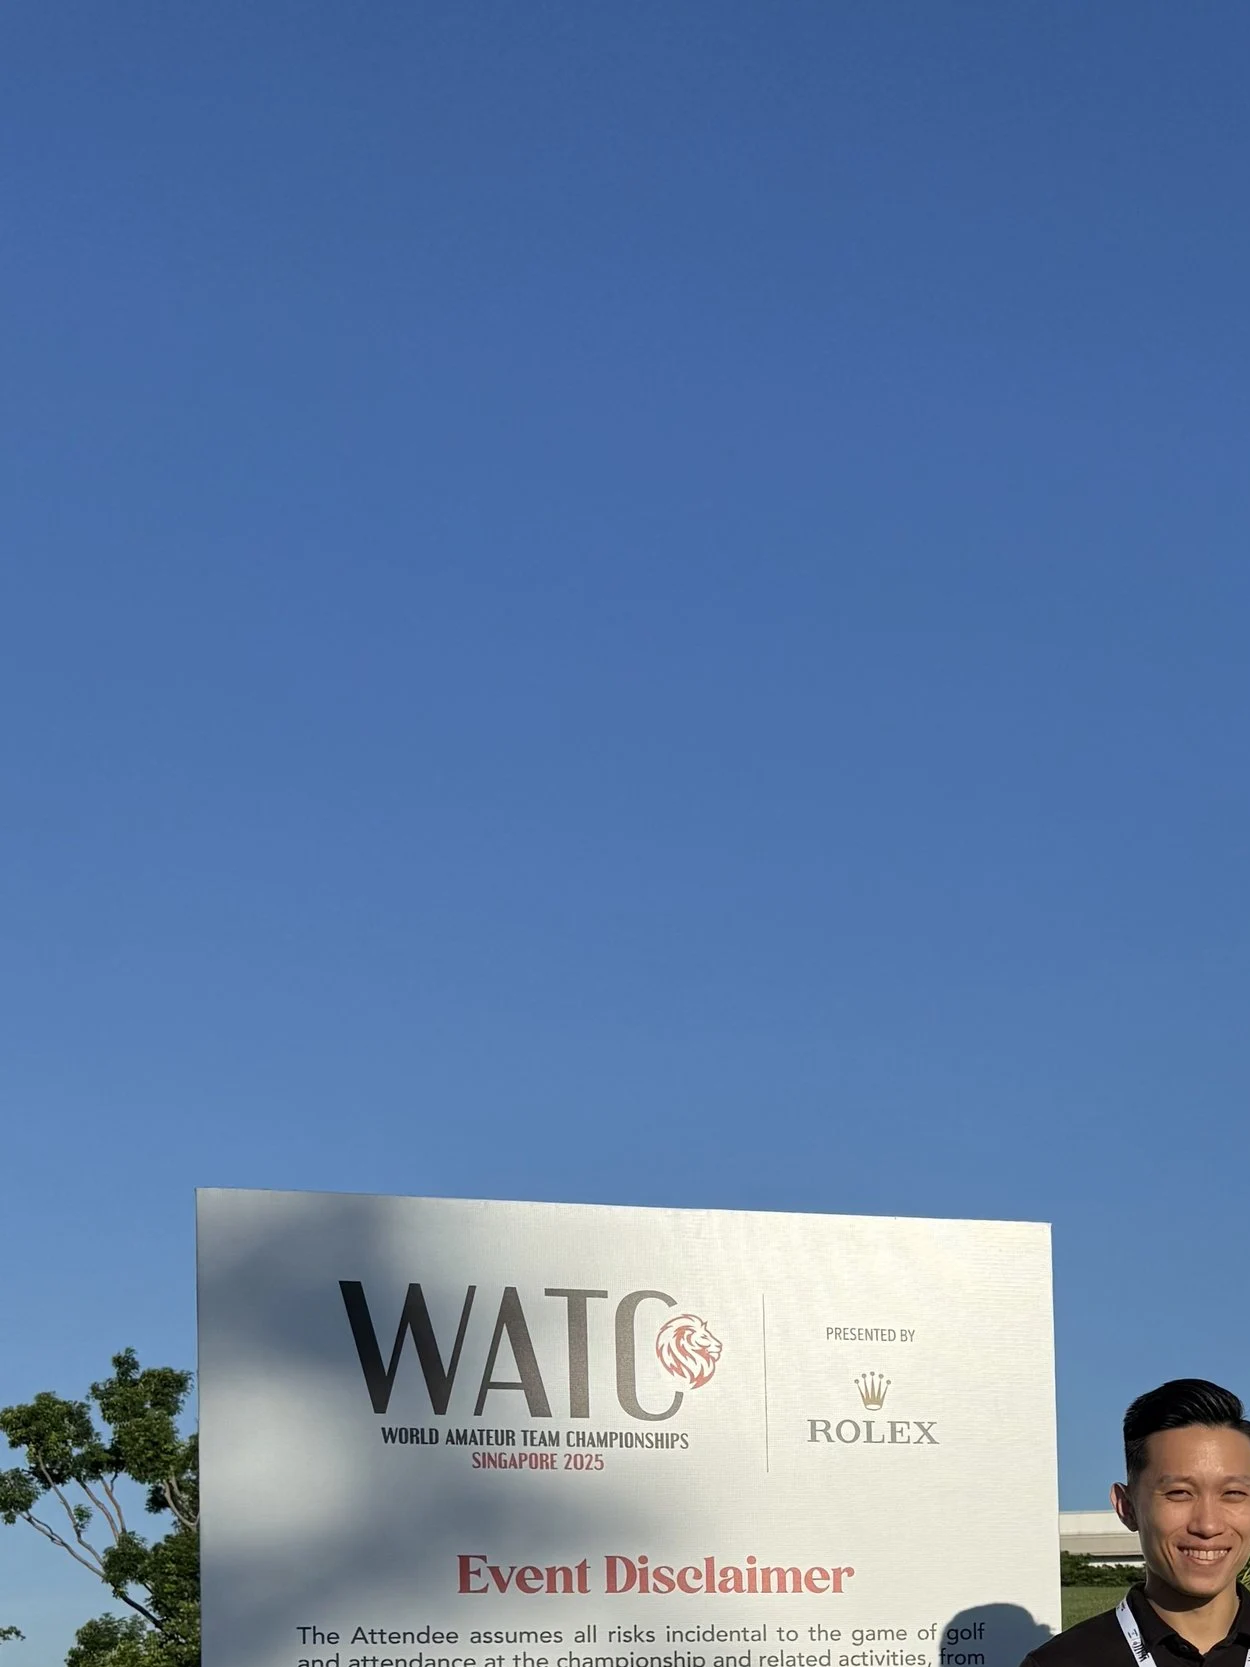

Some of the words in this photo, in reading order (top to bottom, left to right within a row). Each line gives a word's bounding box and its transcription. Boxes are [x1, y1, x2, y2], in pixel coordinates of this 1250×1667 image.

[826, 1327, 896, 1342] PRESENTED
[900, 1329, 915, 1342] BY
[339, 1281, 684, 1421] WATC
[381, 1427, 439, 1444] WORLD
[446, 1428, 516, 1446] AMATEUR
[521, 1430, 560, 1447] TEAM
[566, 1431, 688, 1449] CHAMPIONSHIPS
[807, 1419, 940, 1444] ROLEX
[472, 1452, 558, 1470] SINGAPORE
[564, 1453, 604, 1470] 2025
[457, 1555, 591, 1594] Event
[604, 1555, 854, 1594] Disclaimer
